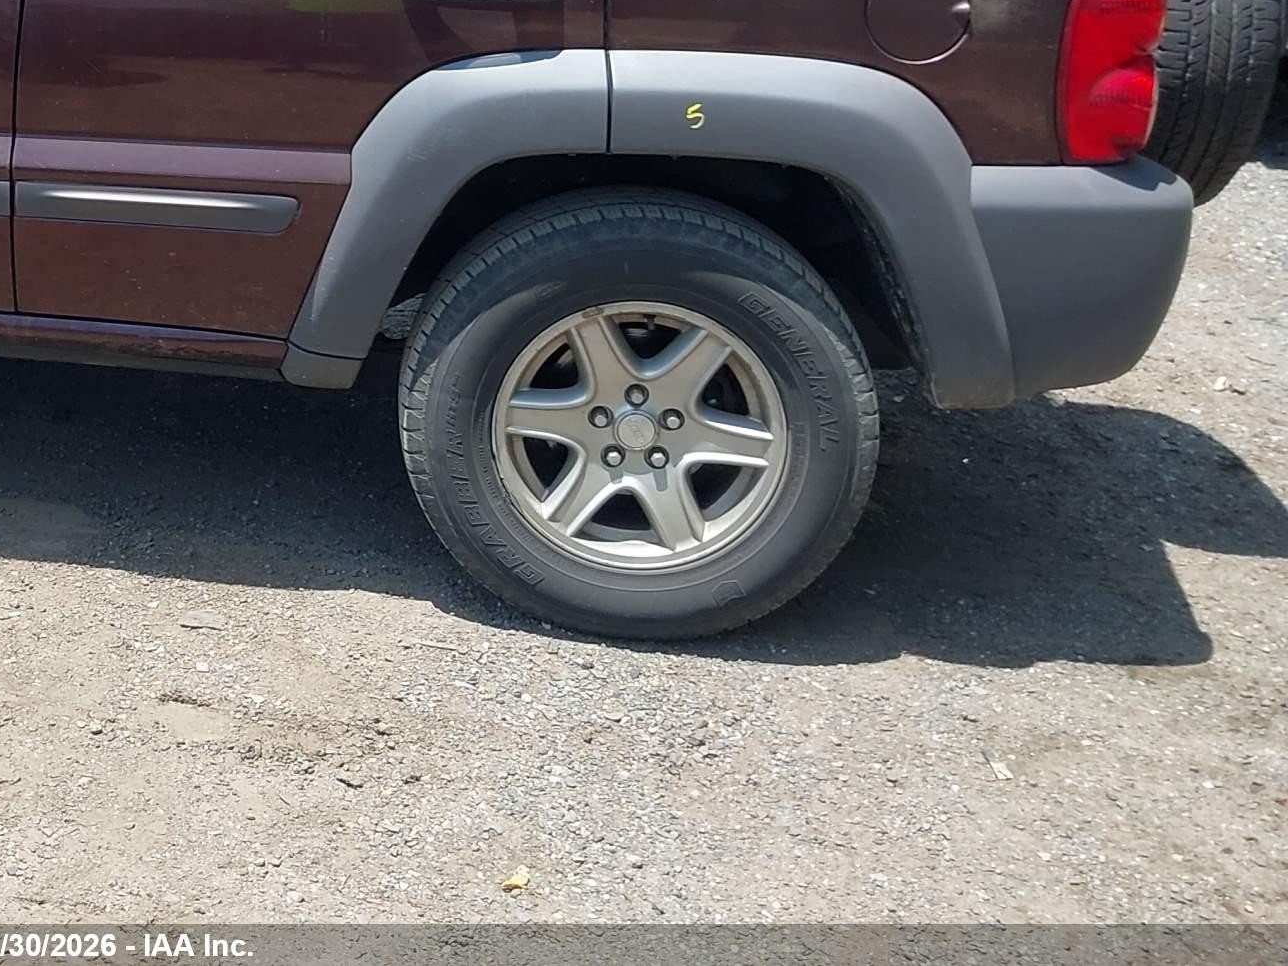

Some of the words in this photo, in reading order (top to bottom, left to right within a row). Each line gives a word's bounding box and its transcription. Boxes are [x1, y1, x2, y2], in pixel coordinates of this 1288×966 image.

[686, 103, 705, 129] 5
[738, 290, 840, 452] GENERAL
[445, 431, 545, 585] GRABBER
